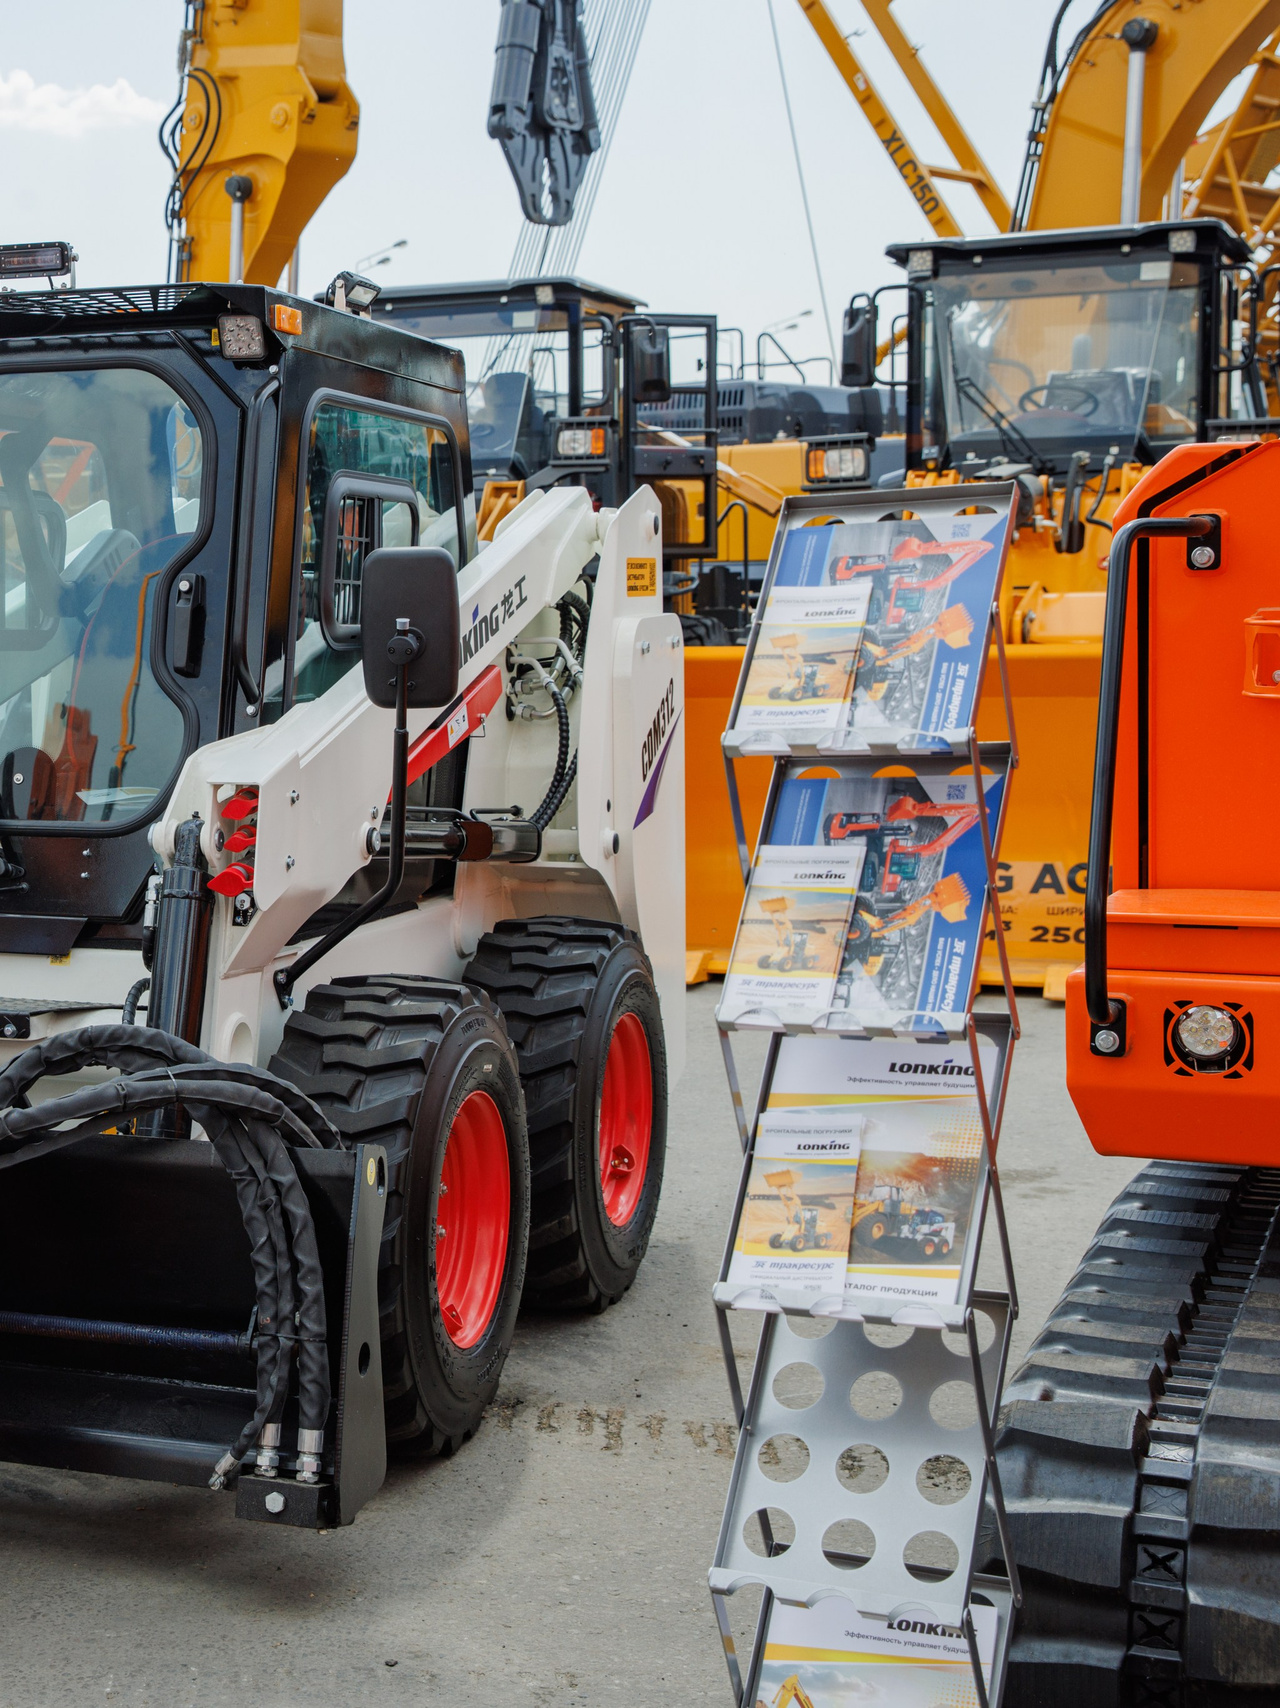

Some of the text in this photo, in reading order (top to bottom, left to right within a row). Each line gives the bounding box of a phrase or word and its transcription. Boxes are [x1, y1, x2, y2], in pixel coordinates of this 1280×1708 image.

[881, 129, 939, 215] XLC150
[641, 677, 675, 783] CDM312
[847, 1076, 903, 1085] Эффективность
[769, 1261, 835, 1271] тракресурс
[880, 1286, 938, 1297] ПРОДУКЦИИ
[844, 1630, 902, 1645] Эффективность
[903, 1640, 941, 1650] управляет
